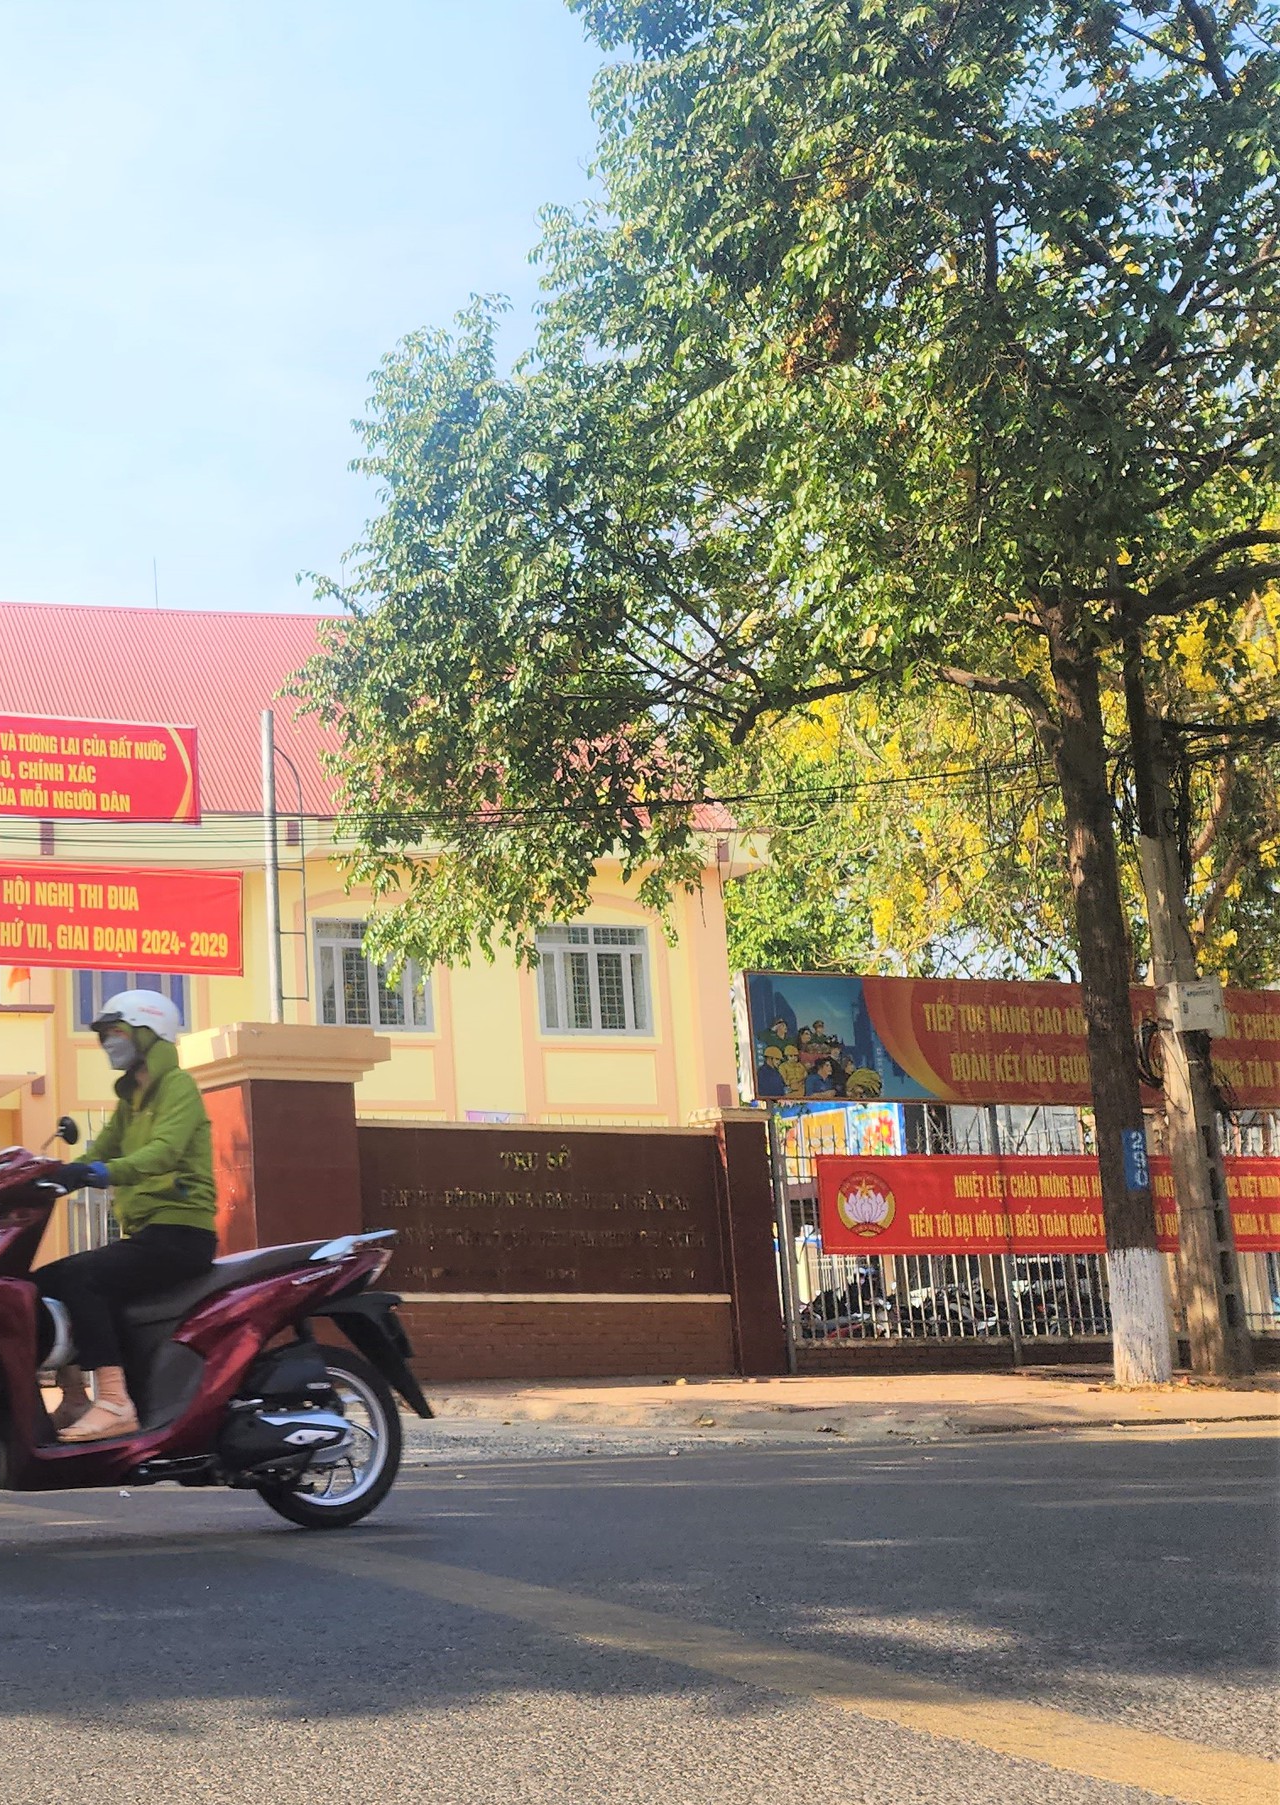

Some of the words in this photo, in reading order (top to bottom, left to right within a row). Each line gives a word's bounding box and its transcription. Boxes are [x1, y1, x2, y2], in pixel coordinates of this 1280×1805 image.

[0, 730, 17, 752] VÀ
[18, 733, 58, 754] TƯƠNG
[60, 737, 80, 755] LAI
[83, 734, 108, 758] CỦA
[109, 735, 132, 759] ĐẤT
[134, 739, 167, 761] NƯỚC
[19, 759, 64, 781] CHÍNH
[68, 762, 96, 783] XÁC
[20, 783, 49, 808] MỖI
[53, 788, 97, 811] NGƯỜI
[100, 791, 130, 813] DÂN
[3, 875, 31, 910] HỘI
[35, 881, 74, 913] NGHỊ
[78, 883, 103, 910] THI
[108, 884, 139, 912] ĐUA
[26, 923, 52, 952] VII,
[57, 924, 89, 951] GIAI
[93, 927, 138, 958] ĐOẠN
[190, 932, 228, 958] 2029
[923, 995, 954, 1032] TIẾP
[958, 1005, 986, 1038] TỤC
[989, 1000, 1032, 1034] NÂNG
[1034, 1006, 1062, 1035] CAO
[950, 1048, 991, 1082] ĐOÀN
[1026, 1049, 1056, 1082] NÊU
[954, 1171, 984, 1203] NHIỆT
[987, 1171, 1007, 1203] LIỆT
[1010, 1171, 1038, 1198] CHÀO
[1039, 1171, 1070, 1198] MỪNG
[1072, 1175, 1090, 1202] ĐẠI
[909, 1207, 933, 1237] TIẾN
[935, 1210, 953, 1237] TỚI
[954, 1214, 972, 1242] ĐẠI
[975, 1210, 994, 1242] HỘI
[995, 1214, 1014, 1241] ĐẠI
[1016, 1205, 1039, 1237] BIỂU
[1041, 1210, 1069, 1237] TOÀN
[1070, 1207, 1097, 1239] QUỐC
